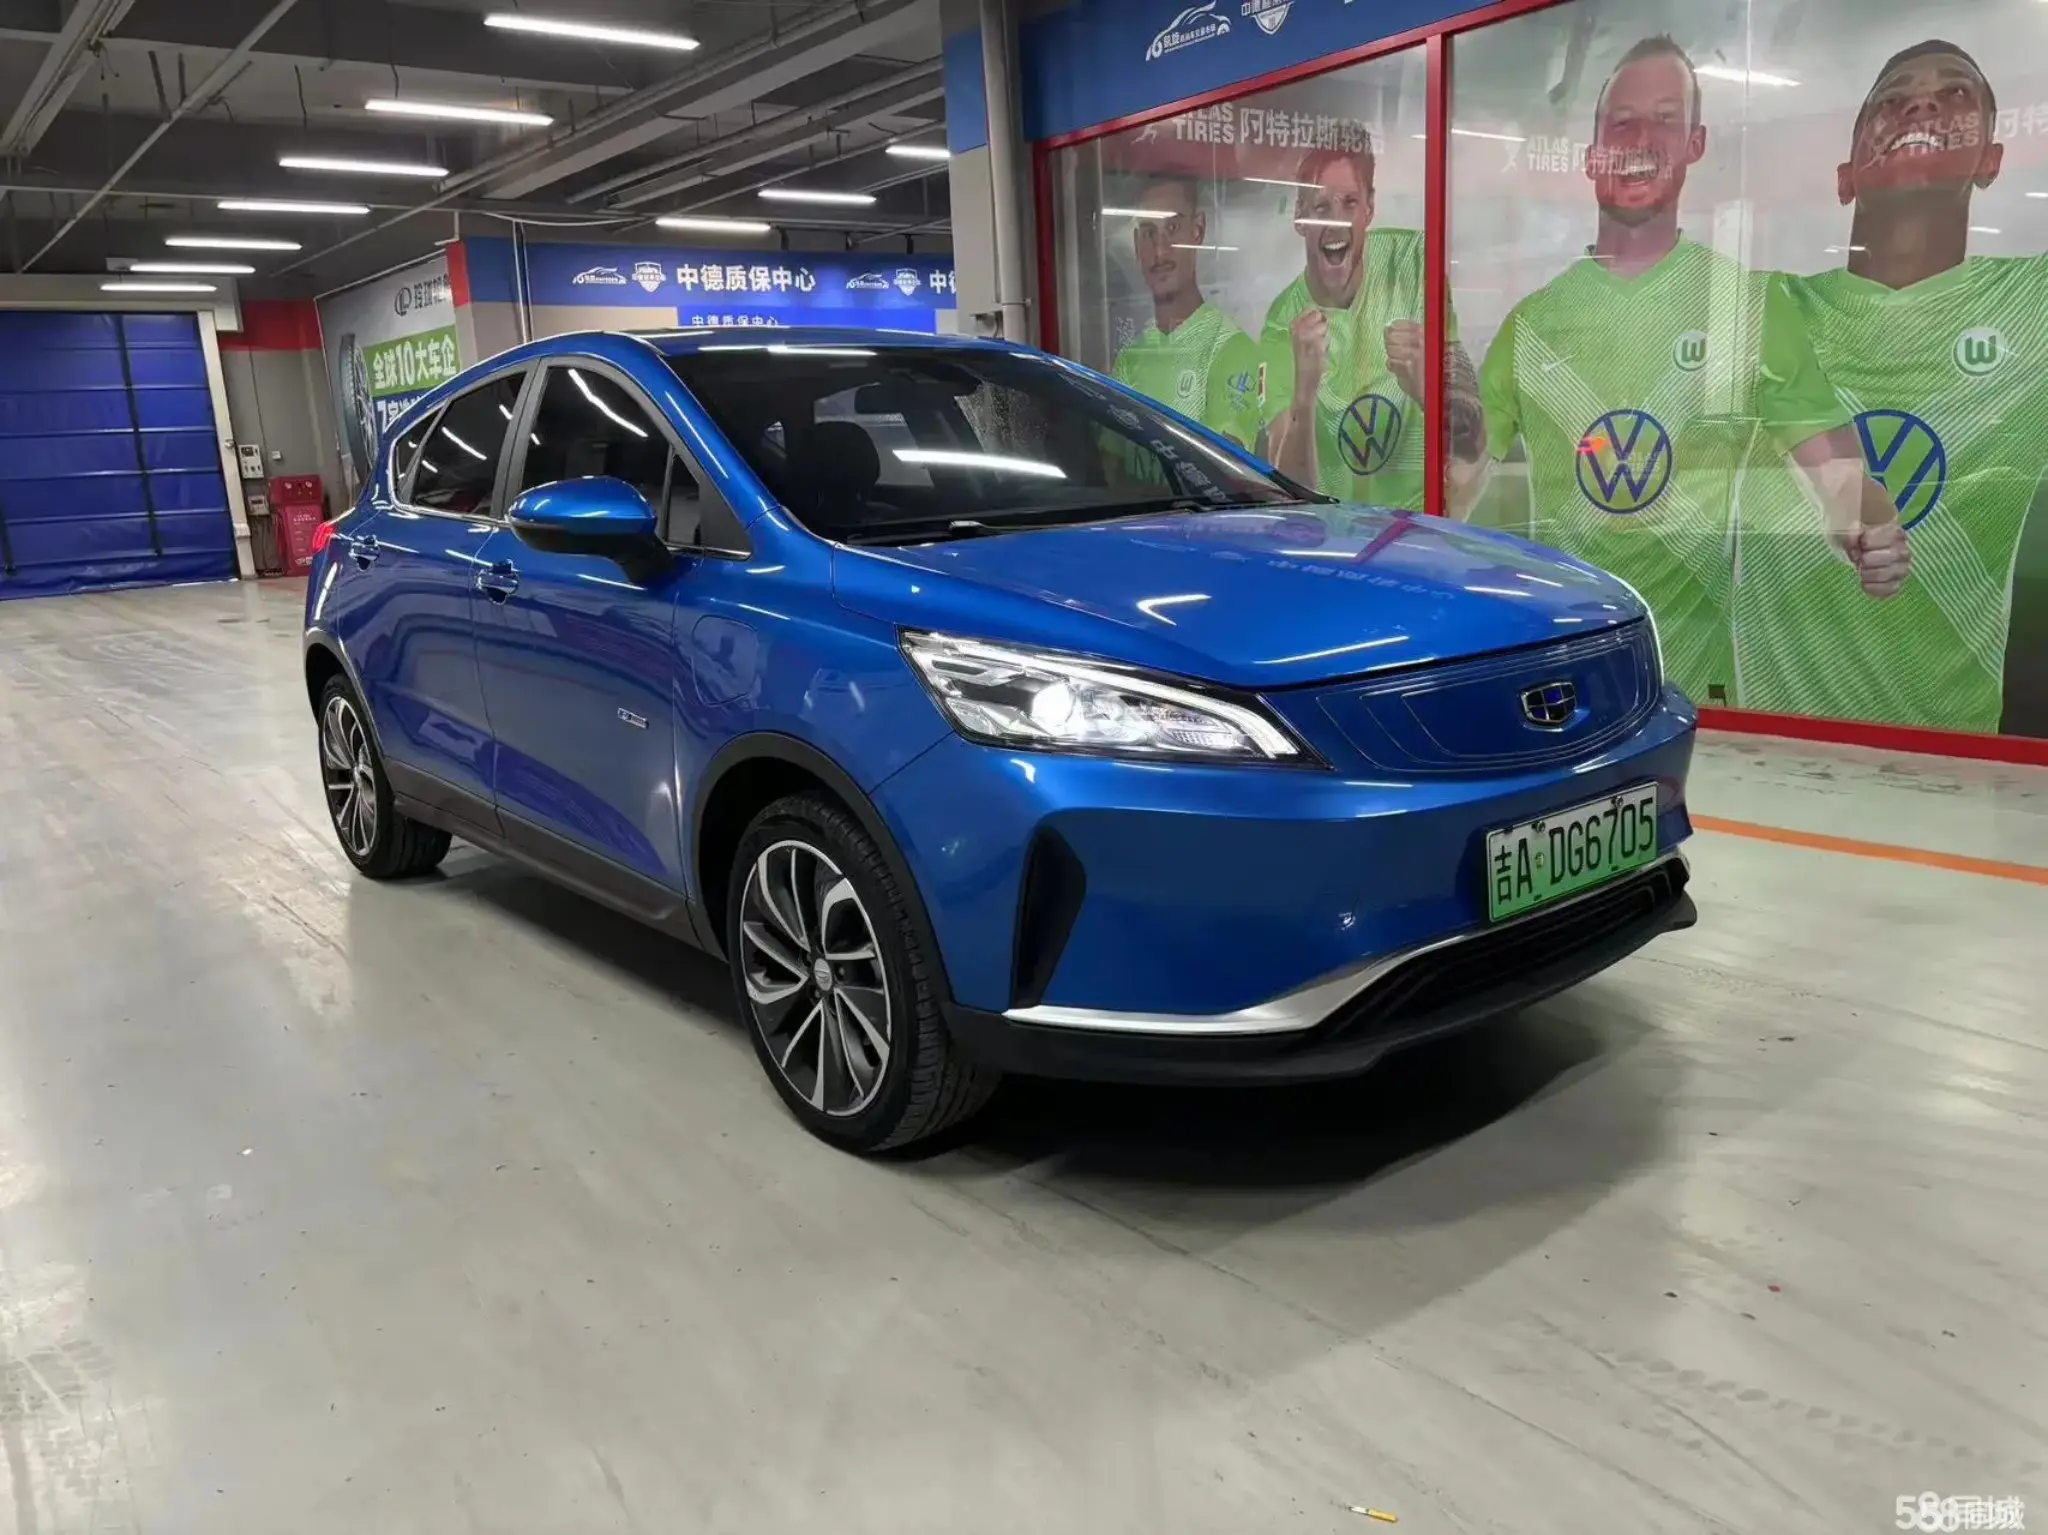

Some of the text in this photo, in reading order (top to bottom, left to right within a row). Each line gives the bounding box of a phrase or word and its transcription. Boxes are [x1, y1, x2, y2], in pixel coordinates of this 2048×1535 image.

[1176, 102, 1235, 122] LAS
[1173, 119, 1236, 145] TIRES
[1526, 136, 1570, 154] ATLAS
[1528, 154, 1569, 173] TIRES
[676, 263, 817, 293] 中德质保中心
[373, 334, 457, 390] 全球10大车企
